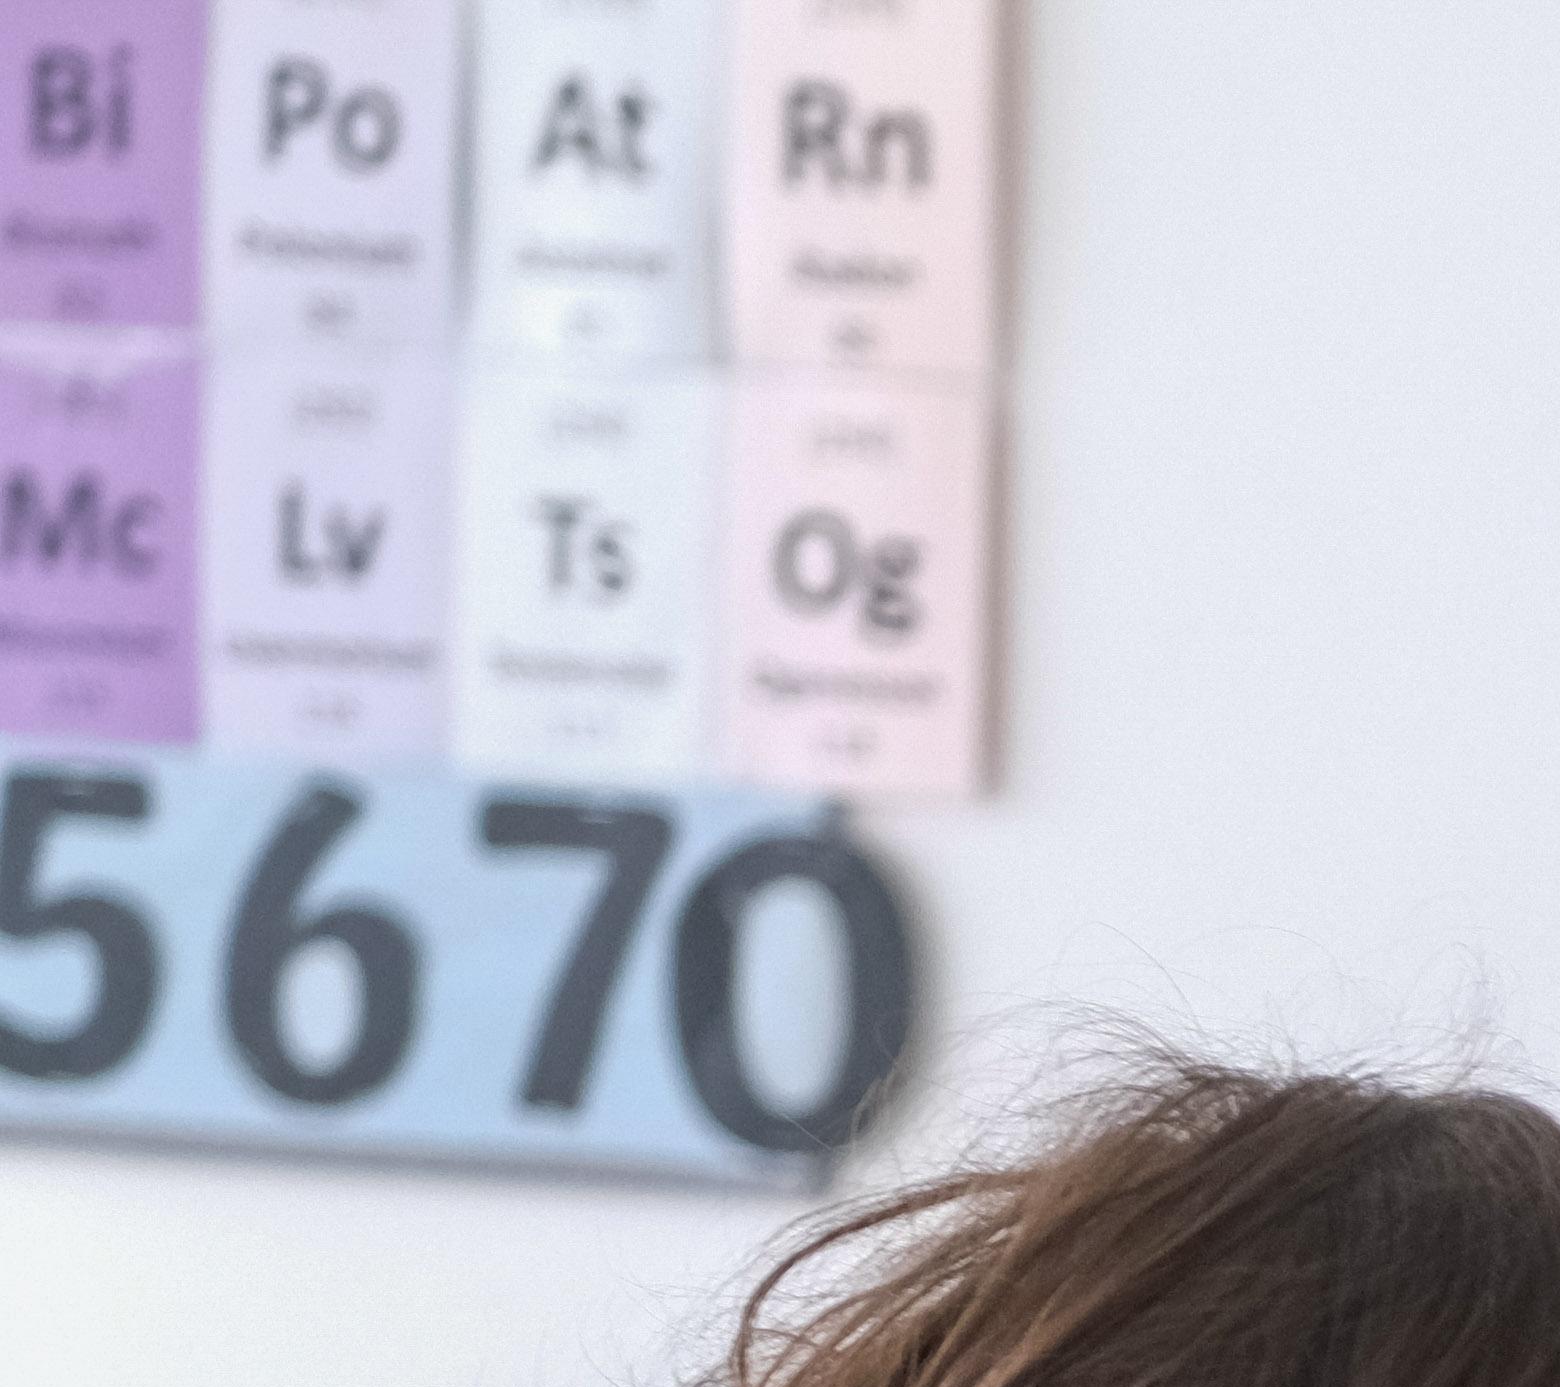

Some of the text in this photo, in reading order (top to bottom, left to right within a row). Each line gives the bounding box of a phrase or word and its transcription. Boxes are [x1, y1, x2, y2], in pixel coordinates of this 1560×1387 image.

[24, 43, 137, 162] Bi
[260, 54, 405, 175] Po
[530, 68, 656, 184] At
[782, 78, 934, 192] Rn
[0, 468, 165, 579] Mc
[278, 480, 389, 587] Lv
[533, 493, 637, 596] Ts
[770, 507, 925, 642] Og
